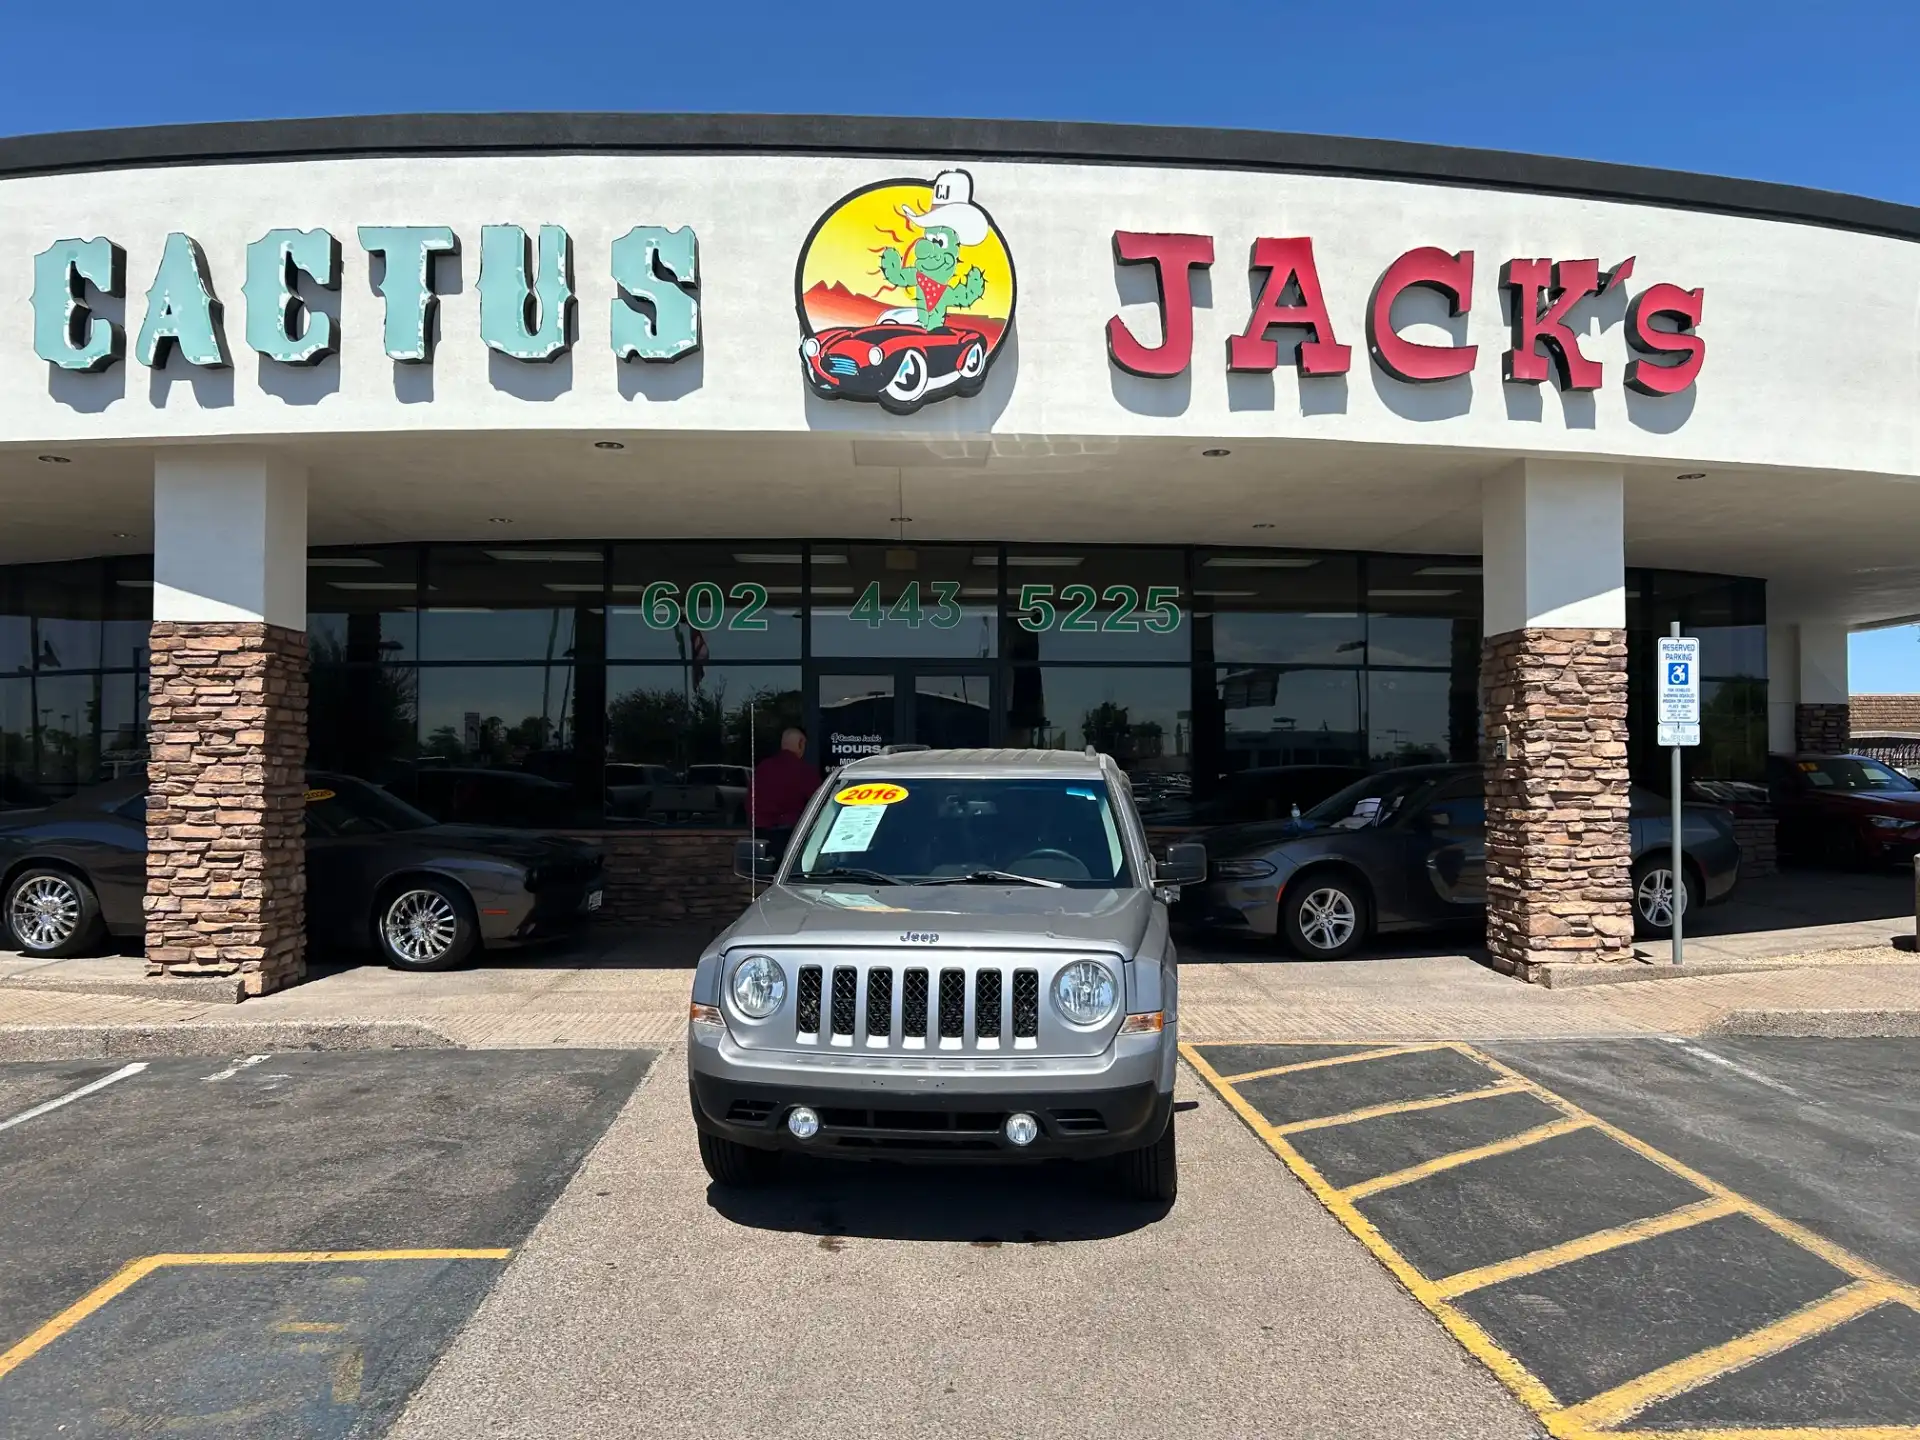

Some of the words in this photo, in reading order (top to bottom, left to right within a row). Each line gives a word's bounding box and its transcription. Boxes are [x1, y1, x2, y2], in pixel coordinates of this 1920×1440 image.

[935, 184, 950, 200] CJ
[29, 224, 702, 372] CACTUS
[641, 580, 769, 631] 602
[847, 580, 963, 630] 443
[1017, 583, 1181, 634] 5225
[1662, 643, 1696, 652] RESERVED
[1665, 653, 1693, 661] PARKING
[832, 744, 881, 754] HOURS
[841, 788, 901, 801] 2016
[899, 931, 940, 945] Jeep
